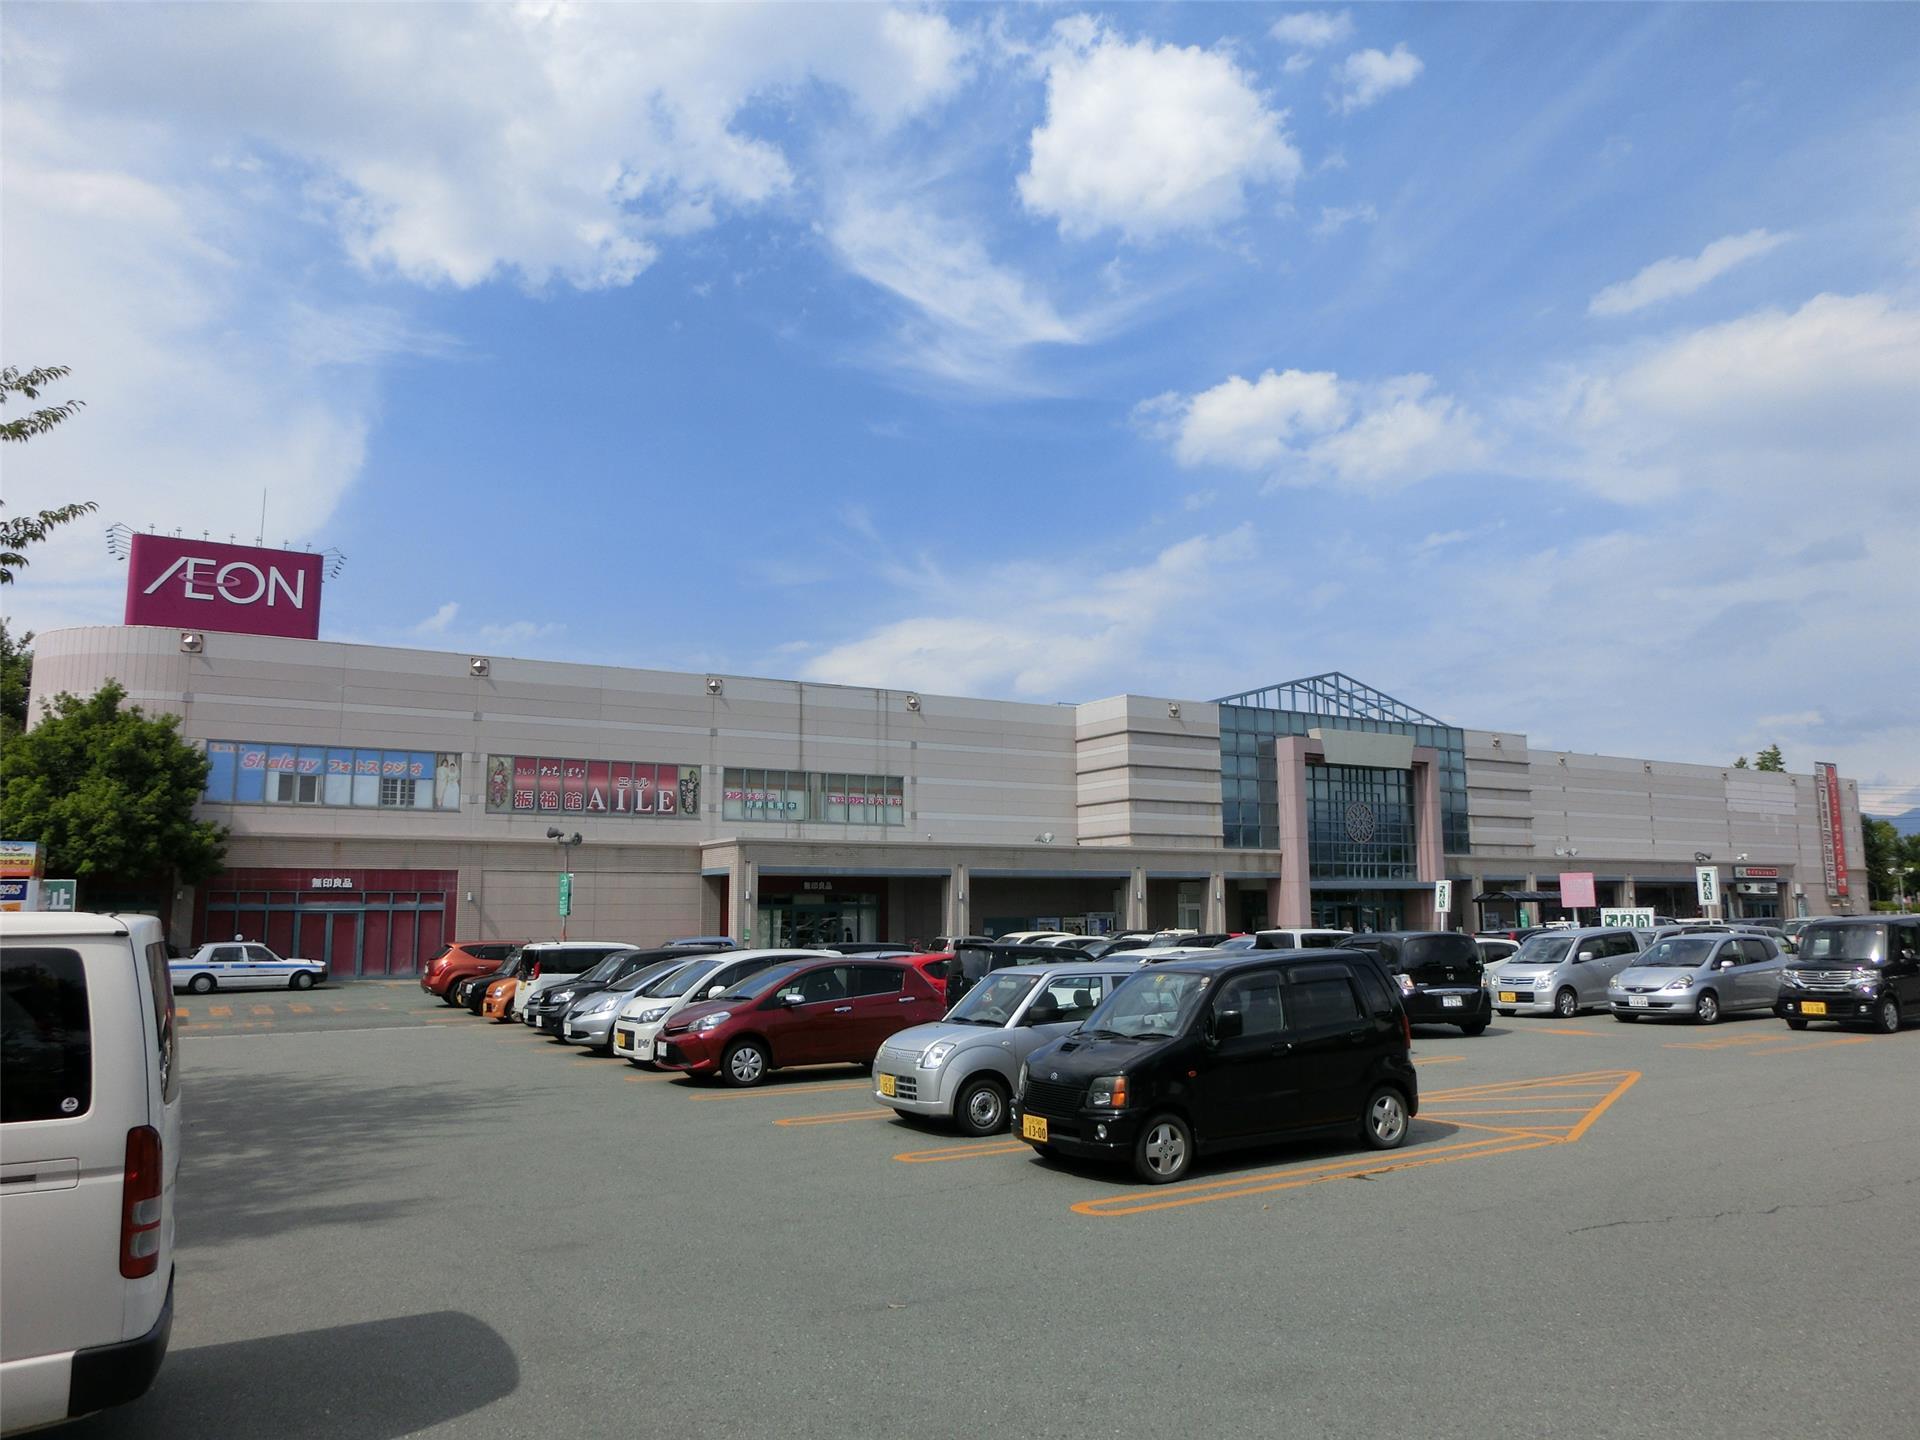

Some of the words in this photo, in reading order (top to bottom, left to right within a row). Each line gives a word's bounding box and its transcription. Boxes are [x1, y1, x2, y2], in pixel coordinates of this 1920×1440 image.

[328, 760, 424, 775] フォトスタジオ
[540, 766, 585, 778] たちばな
[618, 777, 649, 788] エール
[514, 790, 583, 810] 振袖館
[587, 787, 674, 812] AILE
[312, 878, 352, 888] 無印良品
[804, 881, 832, 890] 無印良品
